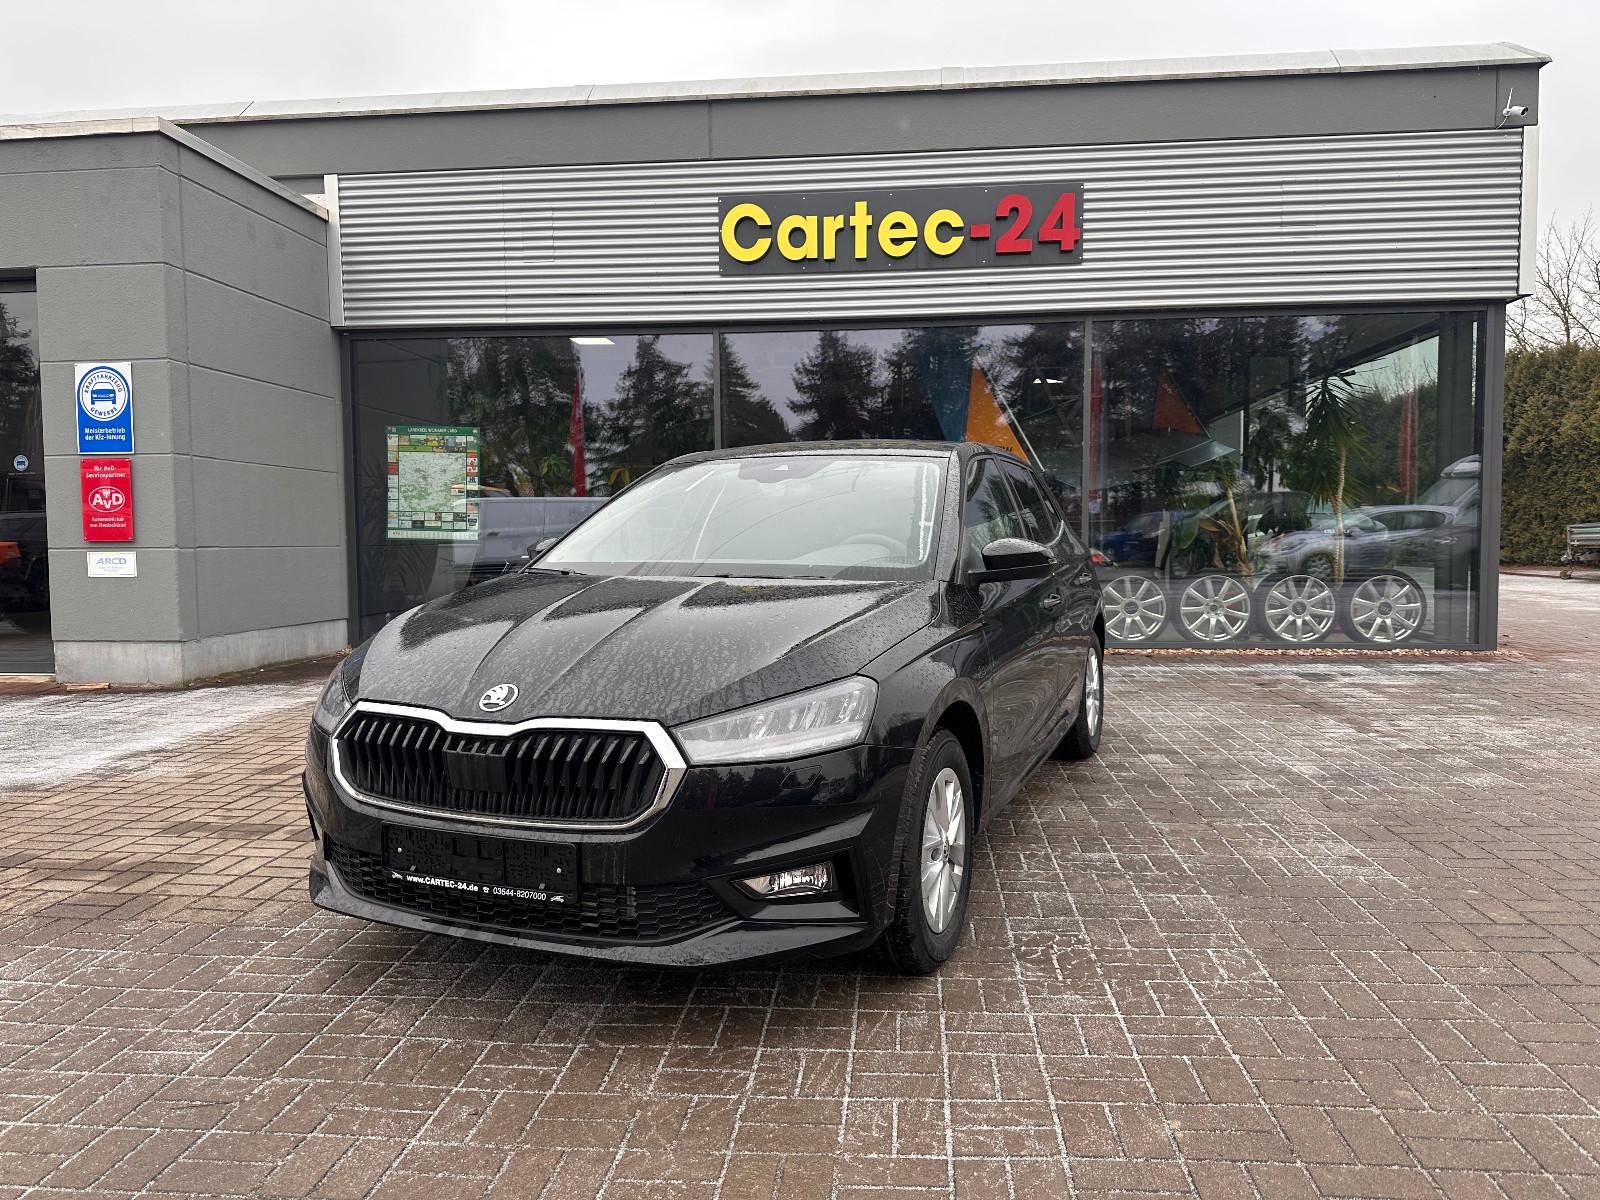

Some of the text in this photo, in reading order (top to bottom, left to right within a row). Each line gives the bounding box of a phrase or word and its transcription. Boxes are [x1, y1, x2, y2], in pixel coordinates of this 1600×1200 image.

[721, 192, 1080, 262] Cartec-24
[90, 407, 118, 417] GEWERBE
[95, 557, 127, 565] ARCD
[406, 874, 547, 901] www.CARTEC-24.de 03644-8207000
